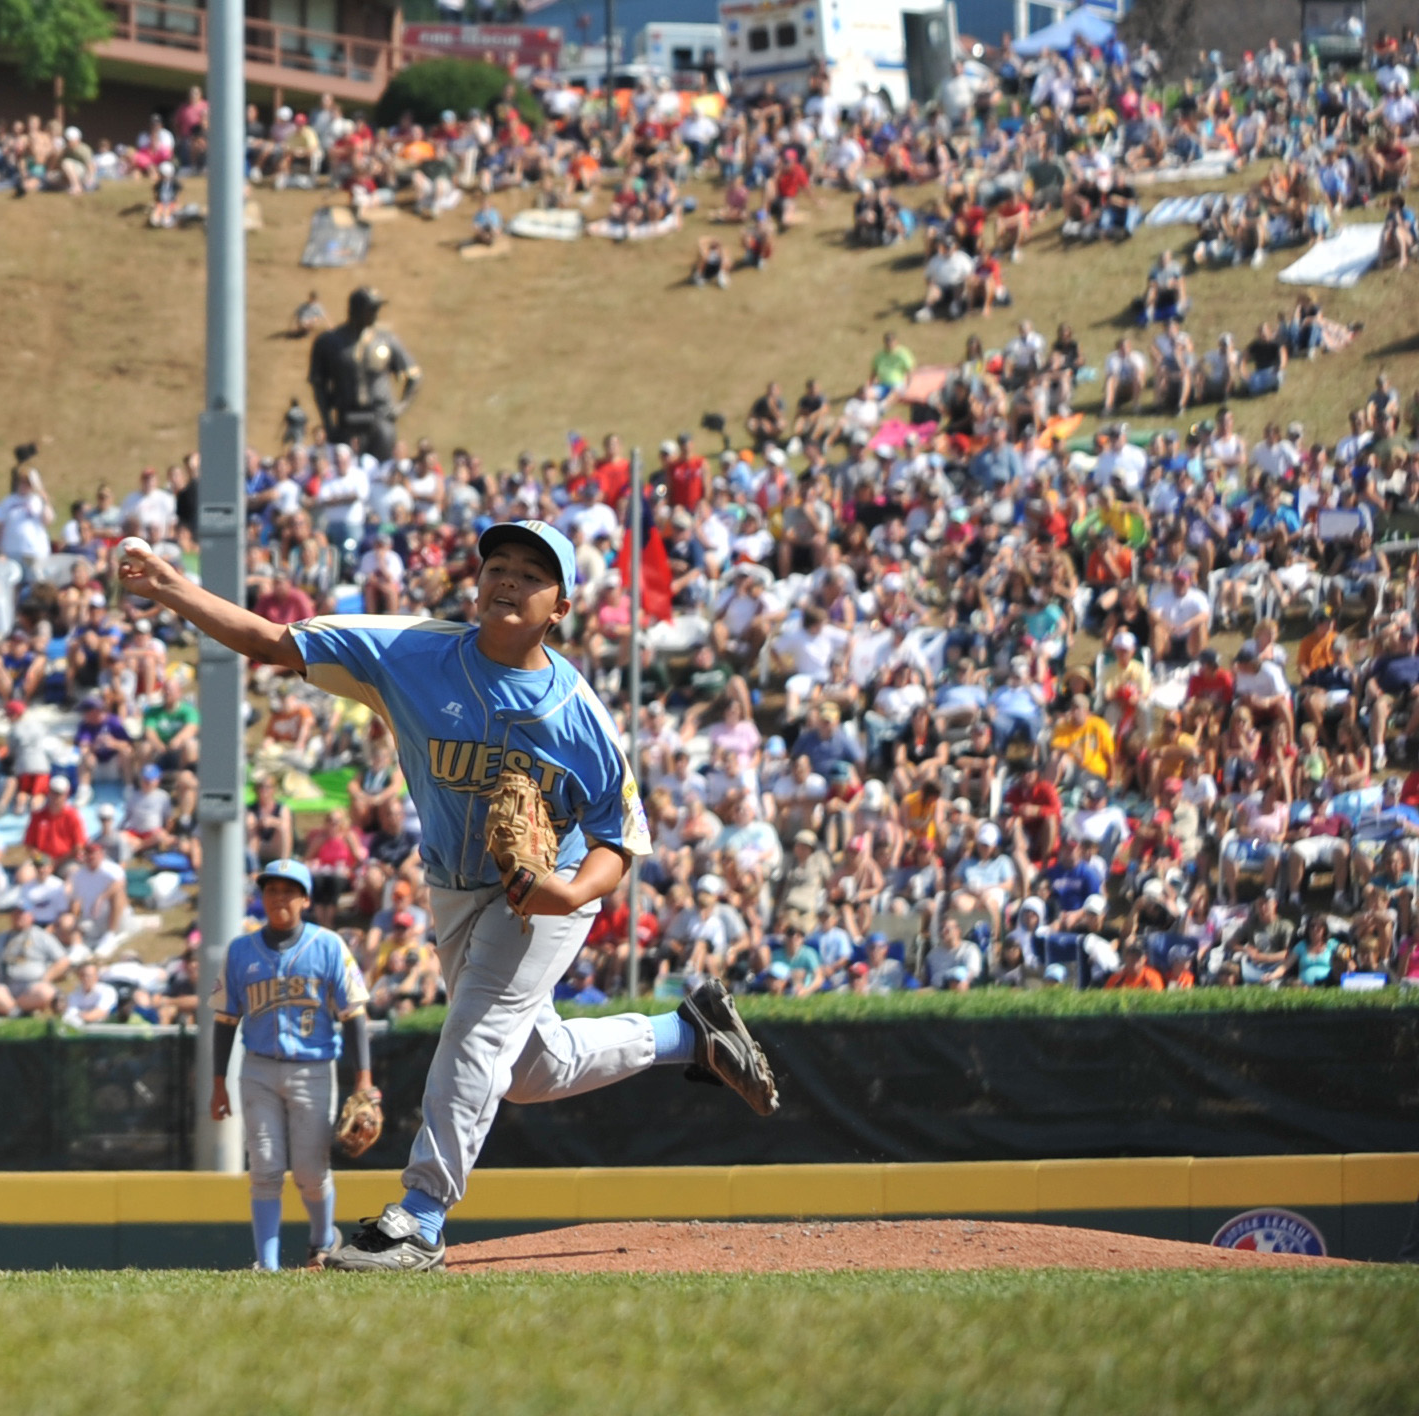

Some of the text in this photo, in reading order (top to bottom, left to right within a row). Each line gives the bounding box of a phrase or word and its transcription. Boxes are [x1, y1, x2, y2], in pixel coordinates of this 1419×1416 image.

[428, 737, 567, 793] WEST
[247, 975, 321, 1014] WEST
[1264, 1215, 1313, 1243] LEAGUE
